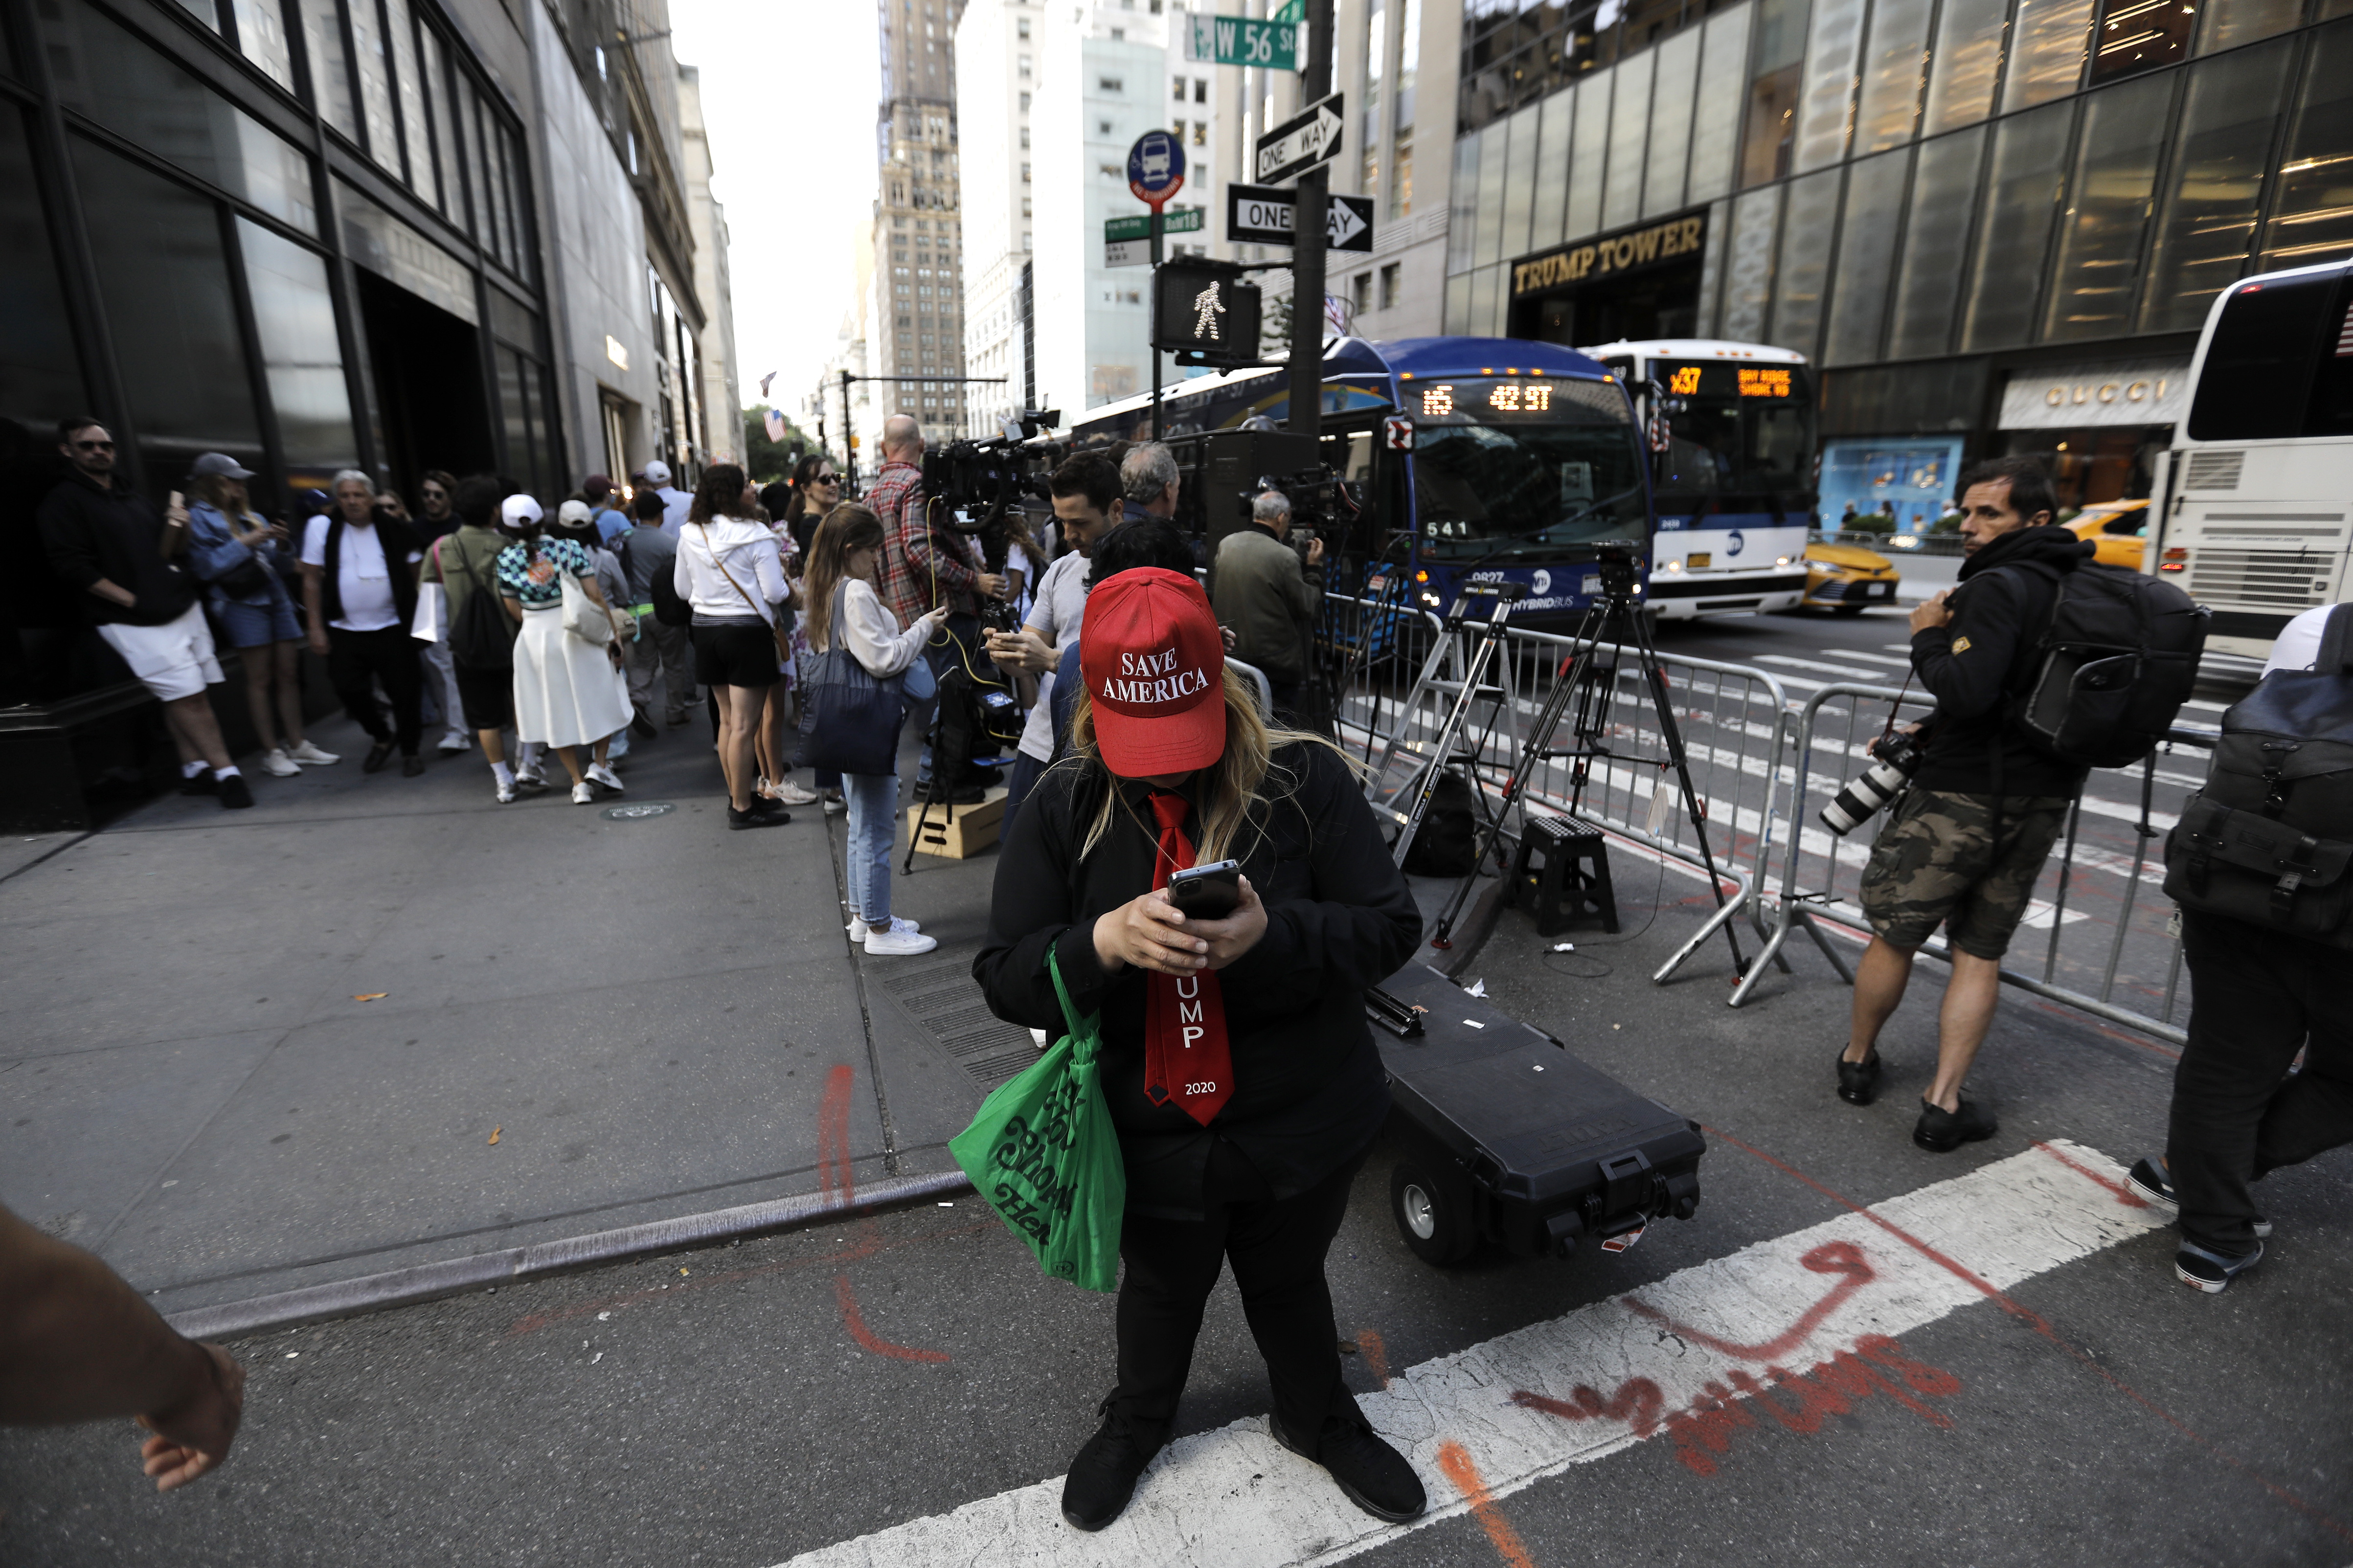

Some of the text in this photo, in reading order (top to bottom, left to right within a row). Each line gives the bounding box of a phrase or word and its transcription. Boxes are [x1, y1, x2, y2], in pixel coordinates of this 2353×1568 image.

[1216, 21, 1294, 64] W 56 St
[1262, 117, 1331, 172] ONE WAY
[1249, 203, 1352, 234] ONE AY
[1515, 217, 1702, 294] TRUMP TOWER
[2046, 379, 2167, 407] GUCCI
[1122, 647, 1177, 677] SAVE
[1103, 667, 1209, 703] AMERICA
[1415, 766, 1440, 821] GORILLA LADDERS
[1176, 976, 1204, 1048] UMP
[1185, 1081, 1216, 1096] 2020
